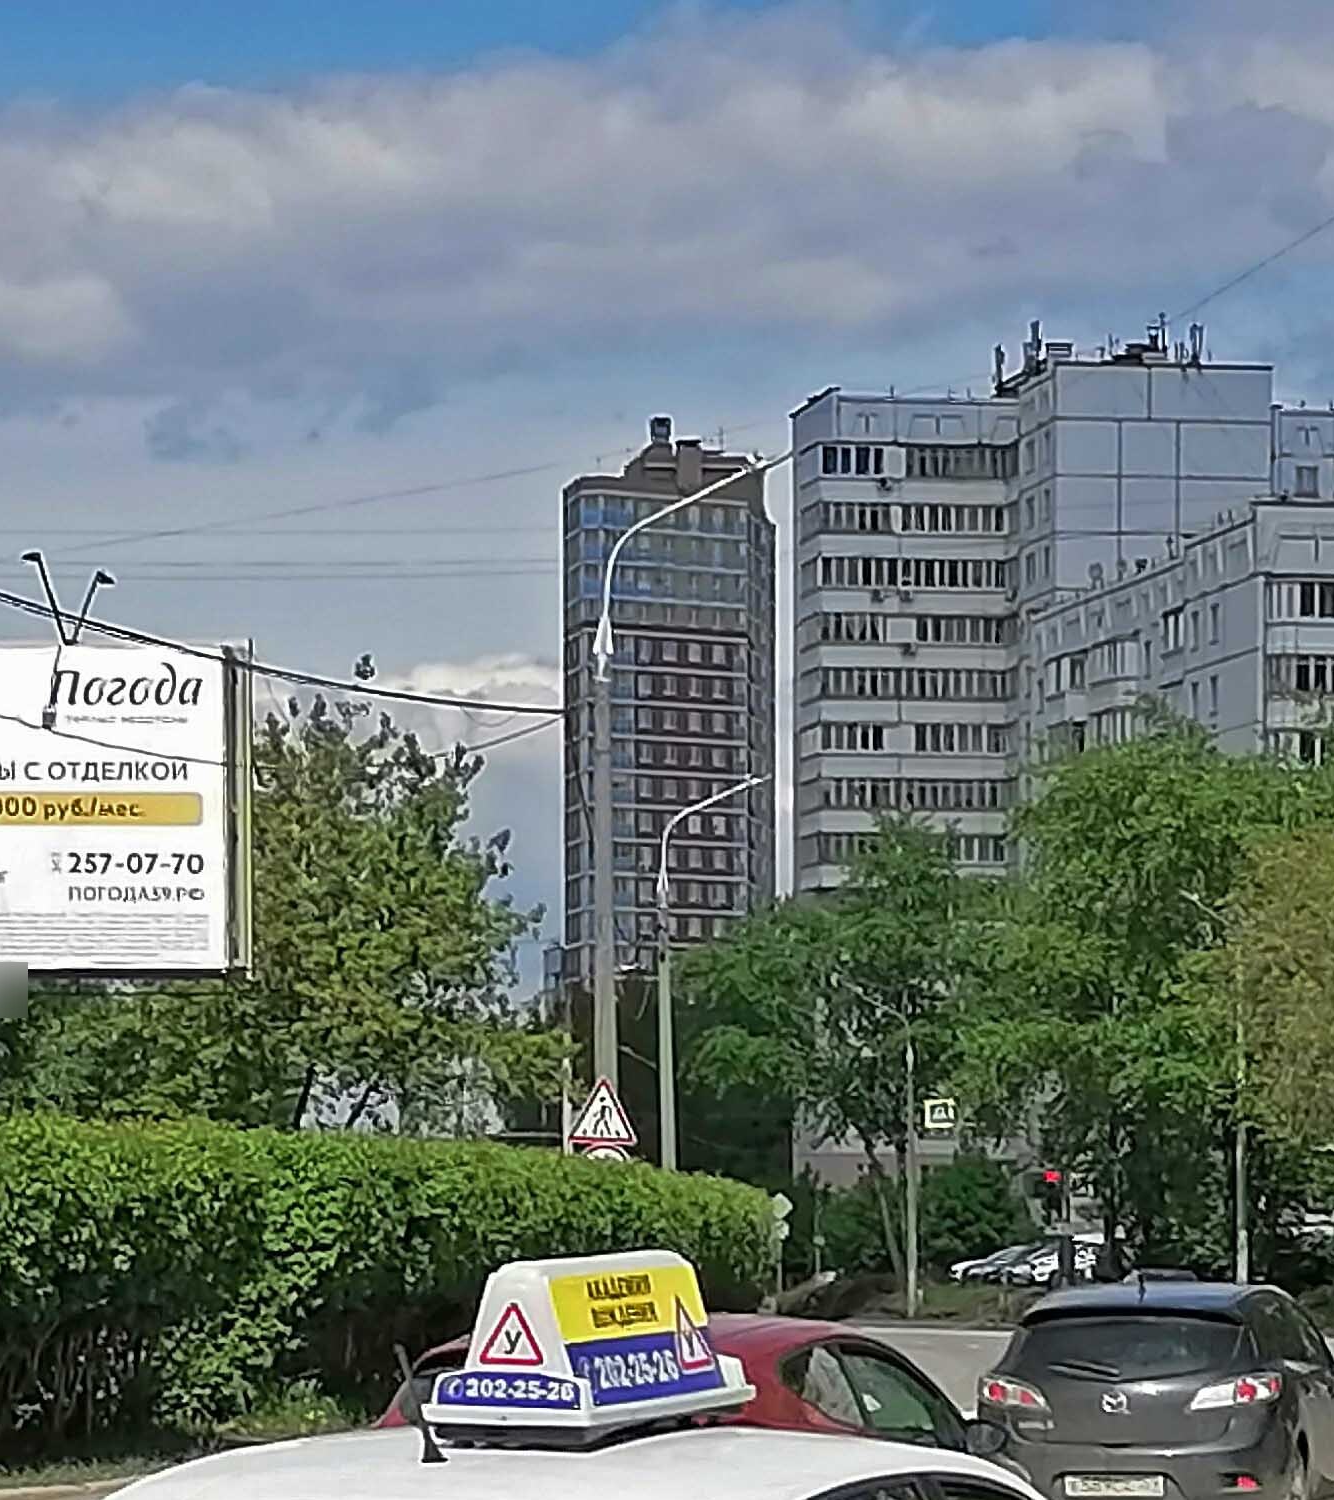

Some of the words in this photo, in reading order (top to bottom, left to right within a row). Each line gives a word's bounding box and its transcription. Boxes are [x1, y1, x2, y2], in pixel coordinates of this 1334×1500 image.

[49, 662, 203, 706] Погода
[24, 760, 43, 781] С
[67, 852, 205, 875] 257-07-70
